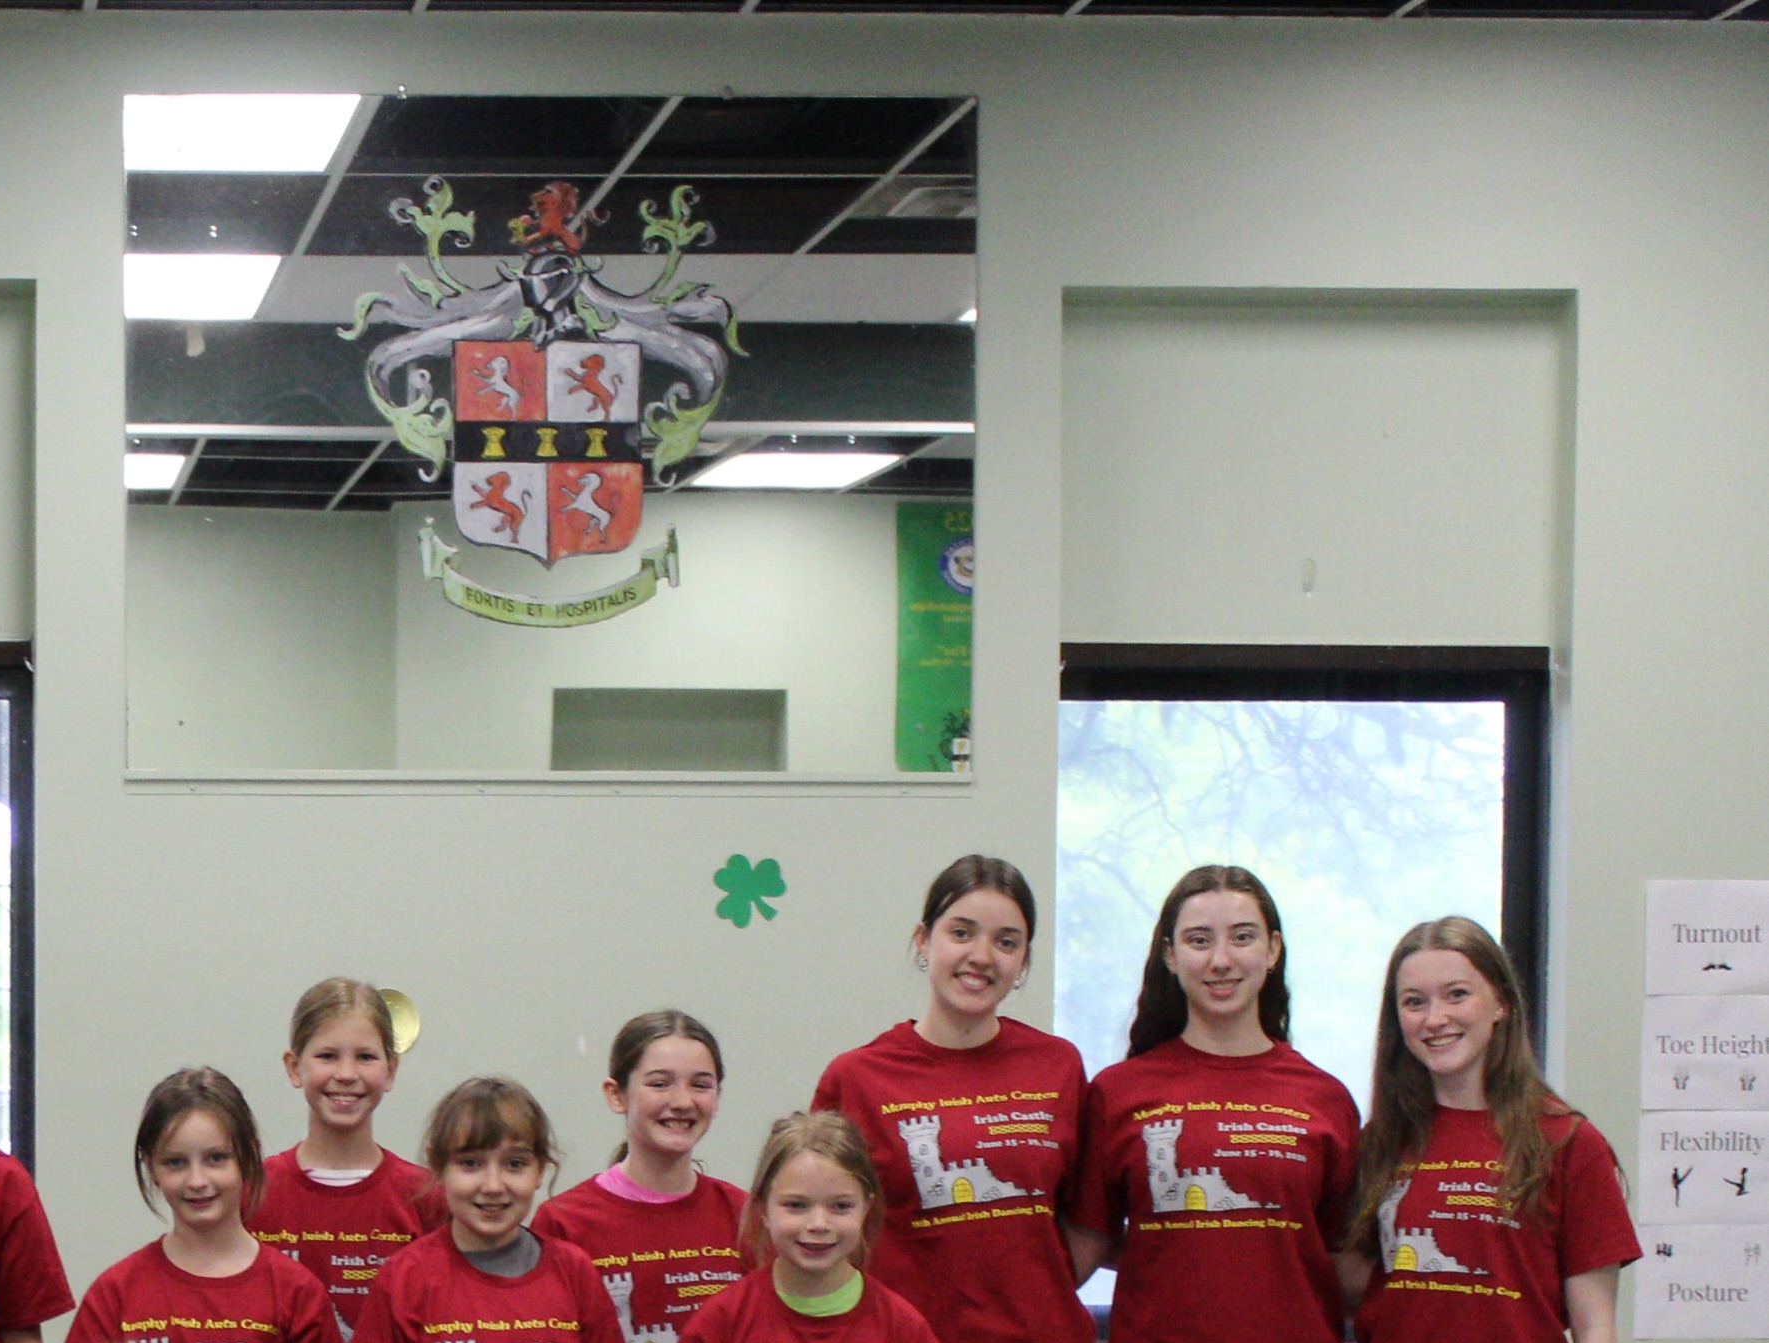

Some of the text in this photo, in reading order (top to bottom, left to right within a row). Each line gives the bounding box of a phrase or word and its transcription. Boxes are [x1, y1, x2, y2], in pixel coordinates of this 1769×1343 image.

[466, 587, 637, 618] FORTIS ET HOSPITALIS
[1672, 924, 1761, 943] Turnout
[1656, 1035, 1769, 1059] Toe Height
[939, 1090, 1059, 1107] Irish Arts Center
[974, 1113, 1009, 1124] Irish
[1134, 1101, 1310, 1121] Murphy Irish Arts Center
[1218, 1122, 1307, 1134] Irish Castles
[1661, 1131, 1765, 1155] Flexibility
[1214, 1149, 1241, 1157] June
[1438, 1182, 1471, 1192] Irish
[1223, 1218, 1287, 1229] Dancing Day
[1474, 1284, 1494, 1295] Day
[1668, 1283, 1748, 1302] Posture
